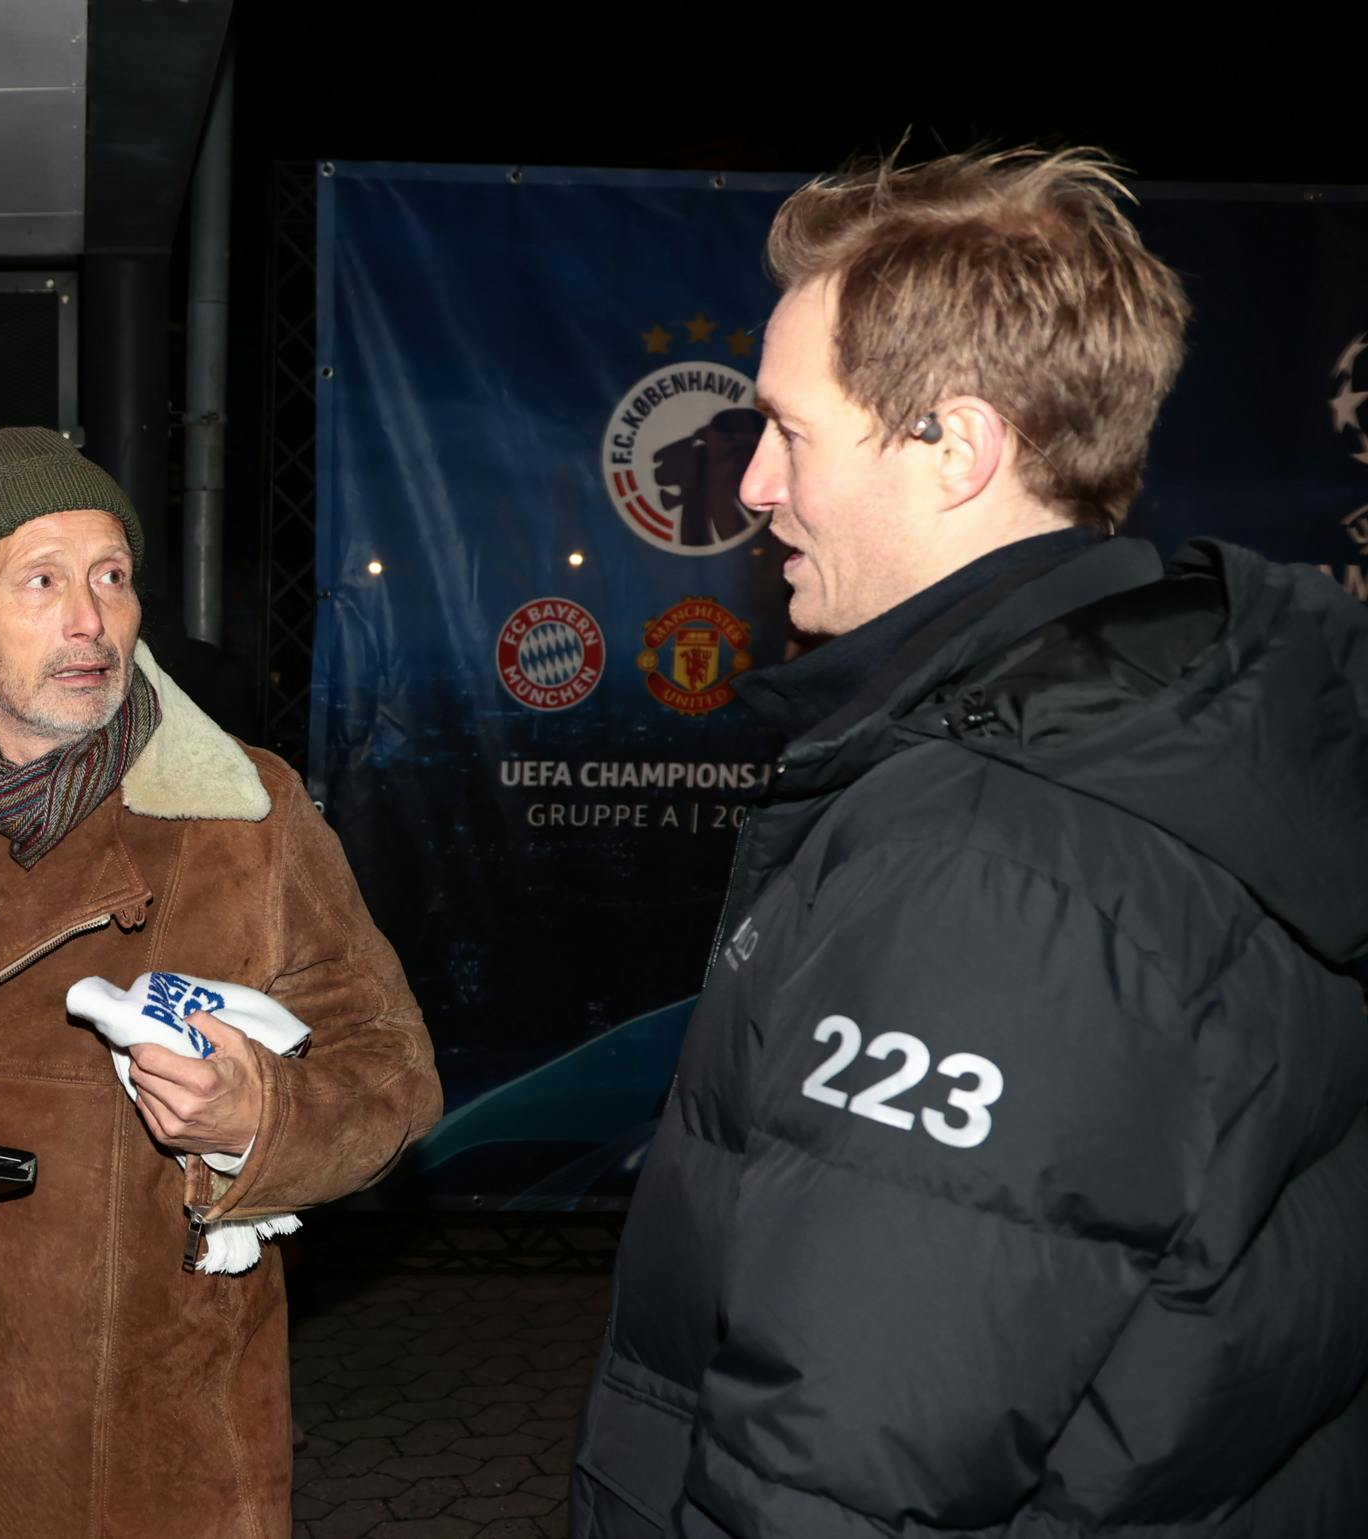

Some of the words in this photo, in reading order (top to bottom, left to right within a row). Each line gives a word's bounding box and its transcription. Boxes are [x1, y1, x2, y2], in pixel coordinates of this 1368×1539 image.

[504, 619, 527, 646] FC
[527, 603, 599, 647] BAYERN
[500, 760, 573, 787] UEFA
[581, 761, 757, 789] CHAMPIONS
[527, 803, 649, 828] GRUPPE
[660, 804, 680, 828] A
[802, 1014, 1004, 1149] 223
